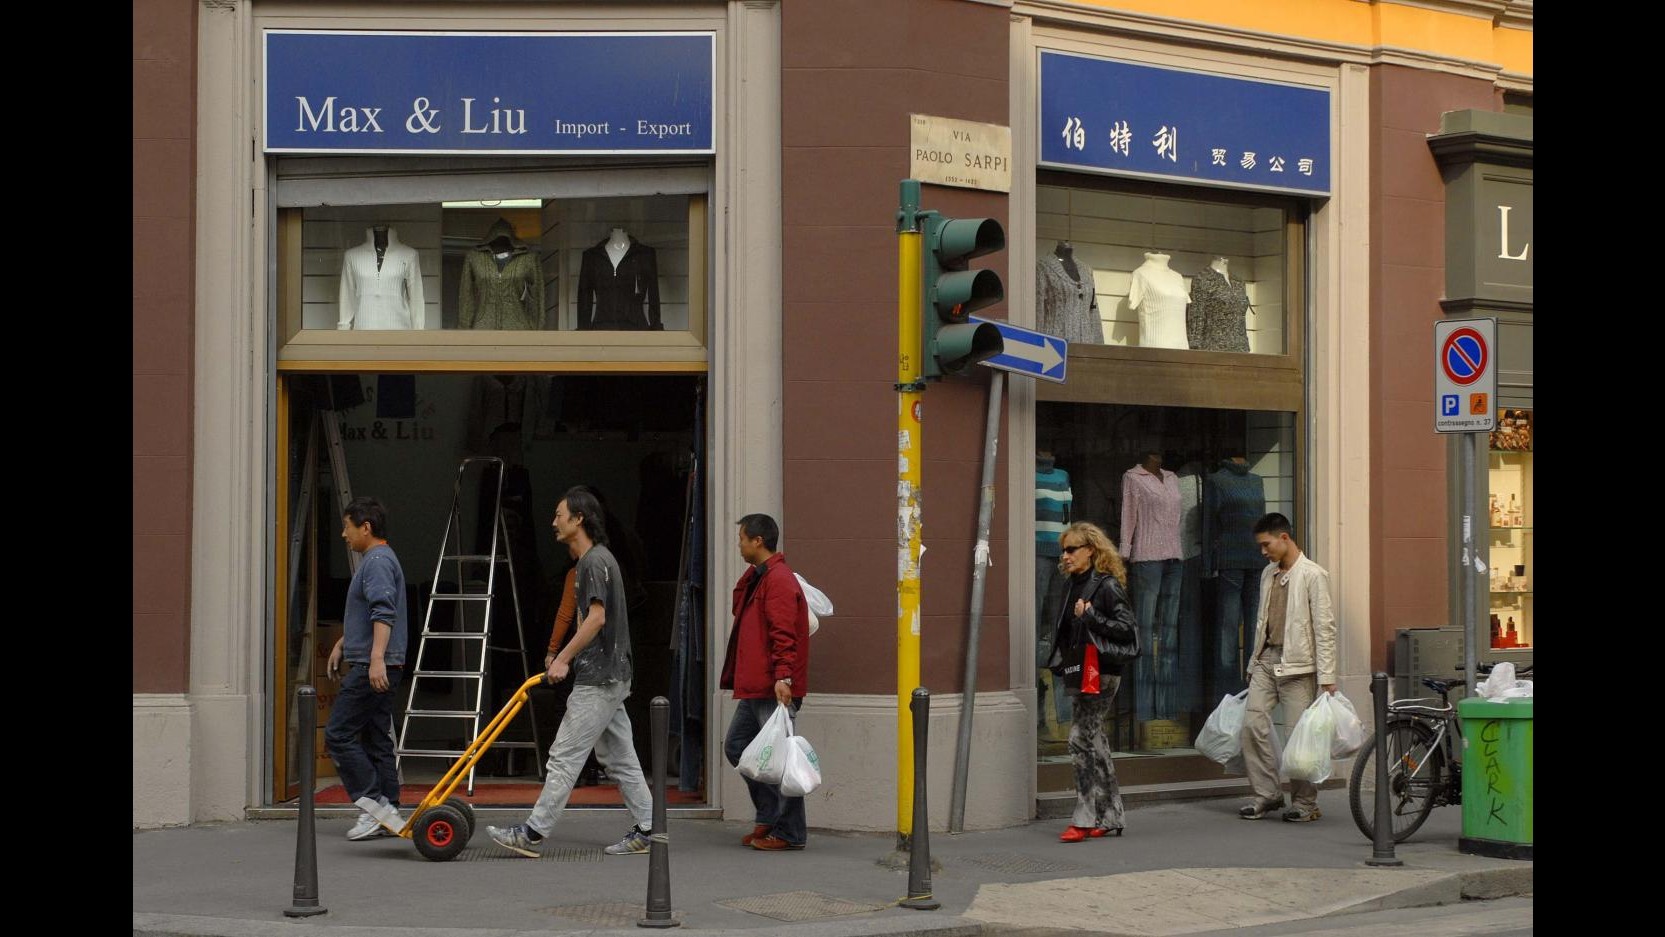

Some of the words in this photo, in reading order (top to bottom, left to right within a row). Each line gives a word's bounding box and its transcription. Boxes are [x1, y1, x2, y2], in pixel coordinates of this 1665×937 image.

[294, 96, 385, 133] Max
[405, 96, 442, 134] &
[460, 96, 529, 135] Liu
[555, 119, 610, 138] Import
[636, 119, 692, 138] Export
[953, 130, 971, 142] VIA
[1062, 116, 1178, 163] 伯特利
[1211, 147, 1314, 176] 贸易公司
[916, 149, 953, 164] PAOLO
[964, 152, 1007, 172] SARPI
[1497, 205, 1529, 261] L
[1445, 397, 1456, 414] P
[371, 420, 388, 440] &
[396, 421, 434, 441] Liu
[1480, 720, 1508, 826] CLARK
